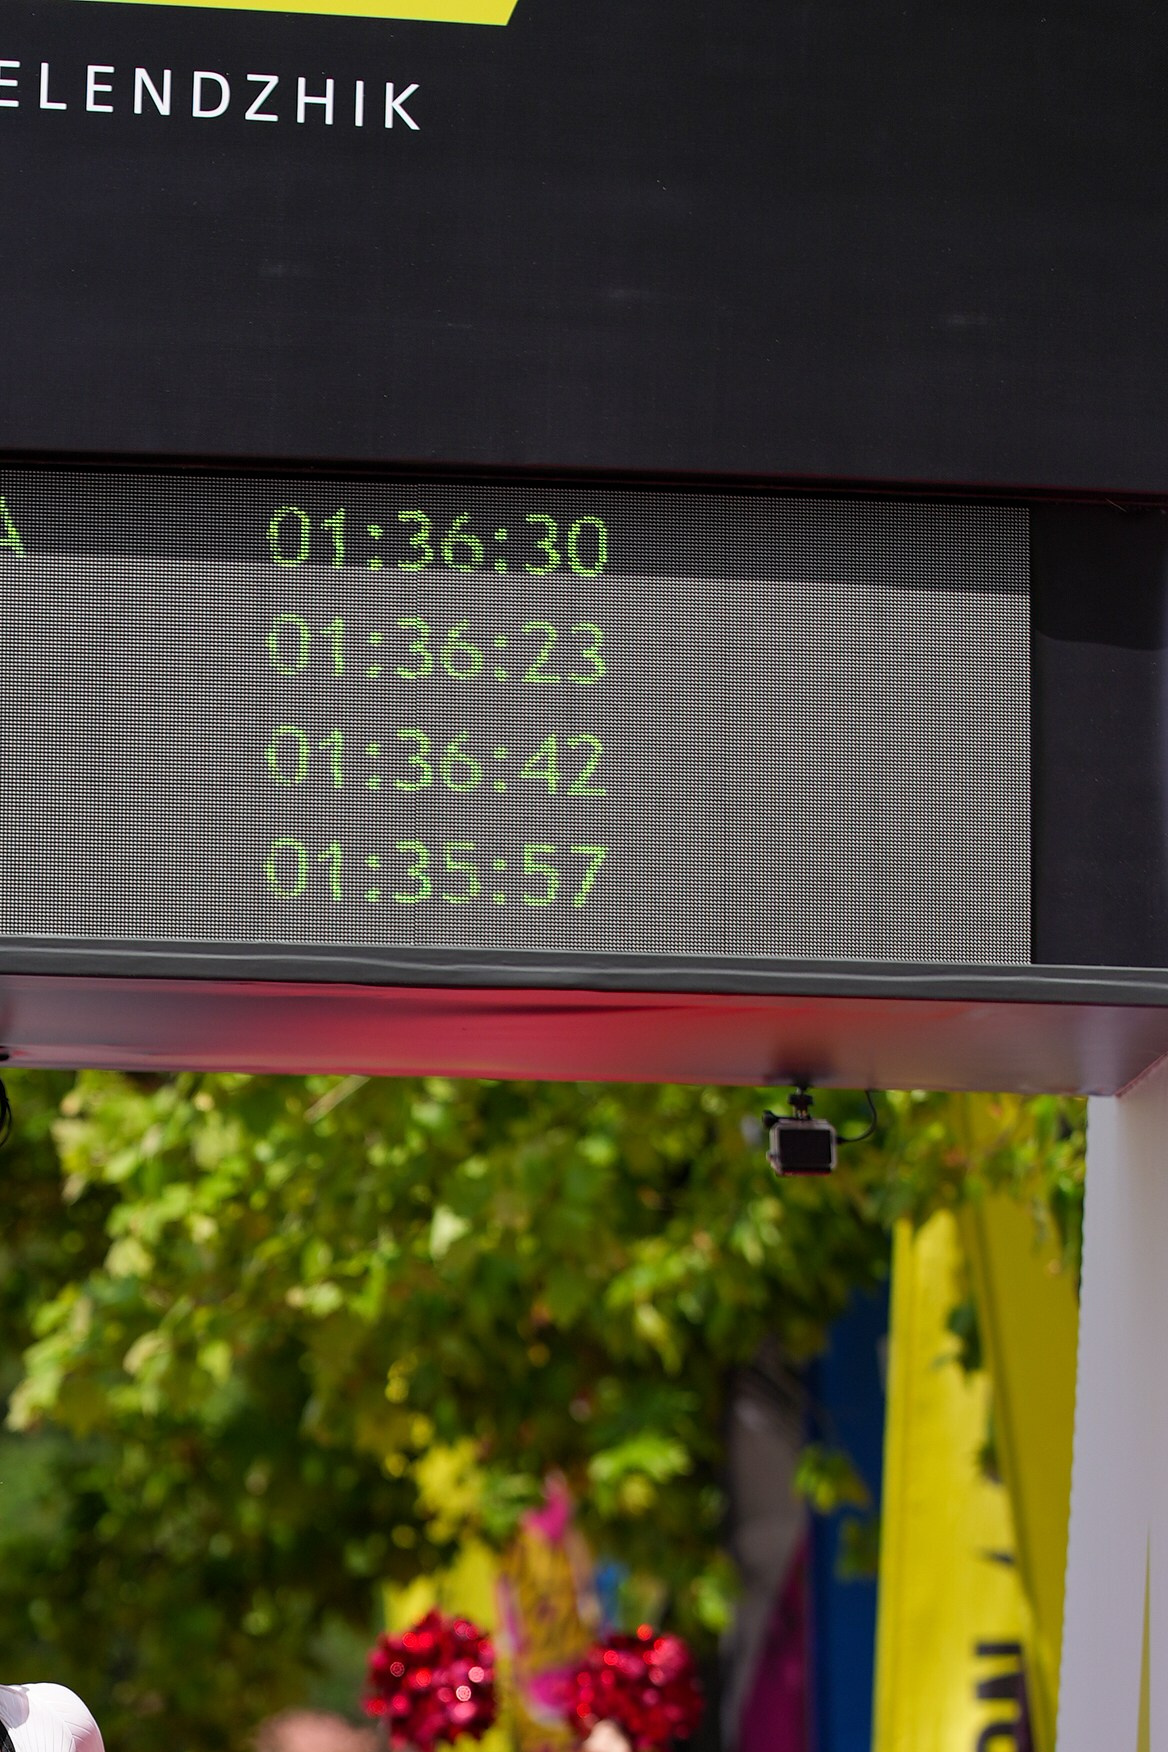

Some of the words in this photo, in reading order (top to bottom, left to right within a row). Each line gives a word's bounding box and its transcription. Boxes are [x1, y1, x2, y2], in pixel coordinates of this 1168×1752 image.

[266, 506, 609, 577] 01:36:30
[265, 613, 608, 684] 01:36:23
[264, 725, 607, 796] 01:36:42
[264, 837, 609, 907] 01:35:57
